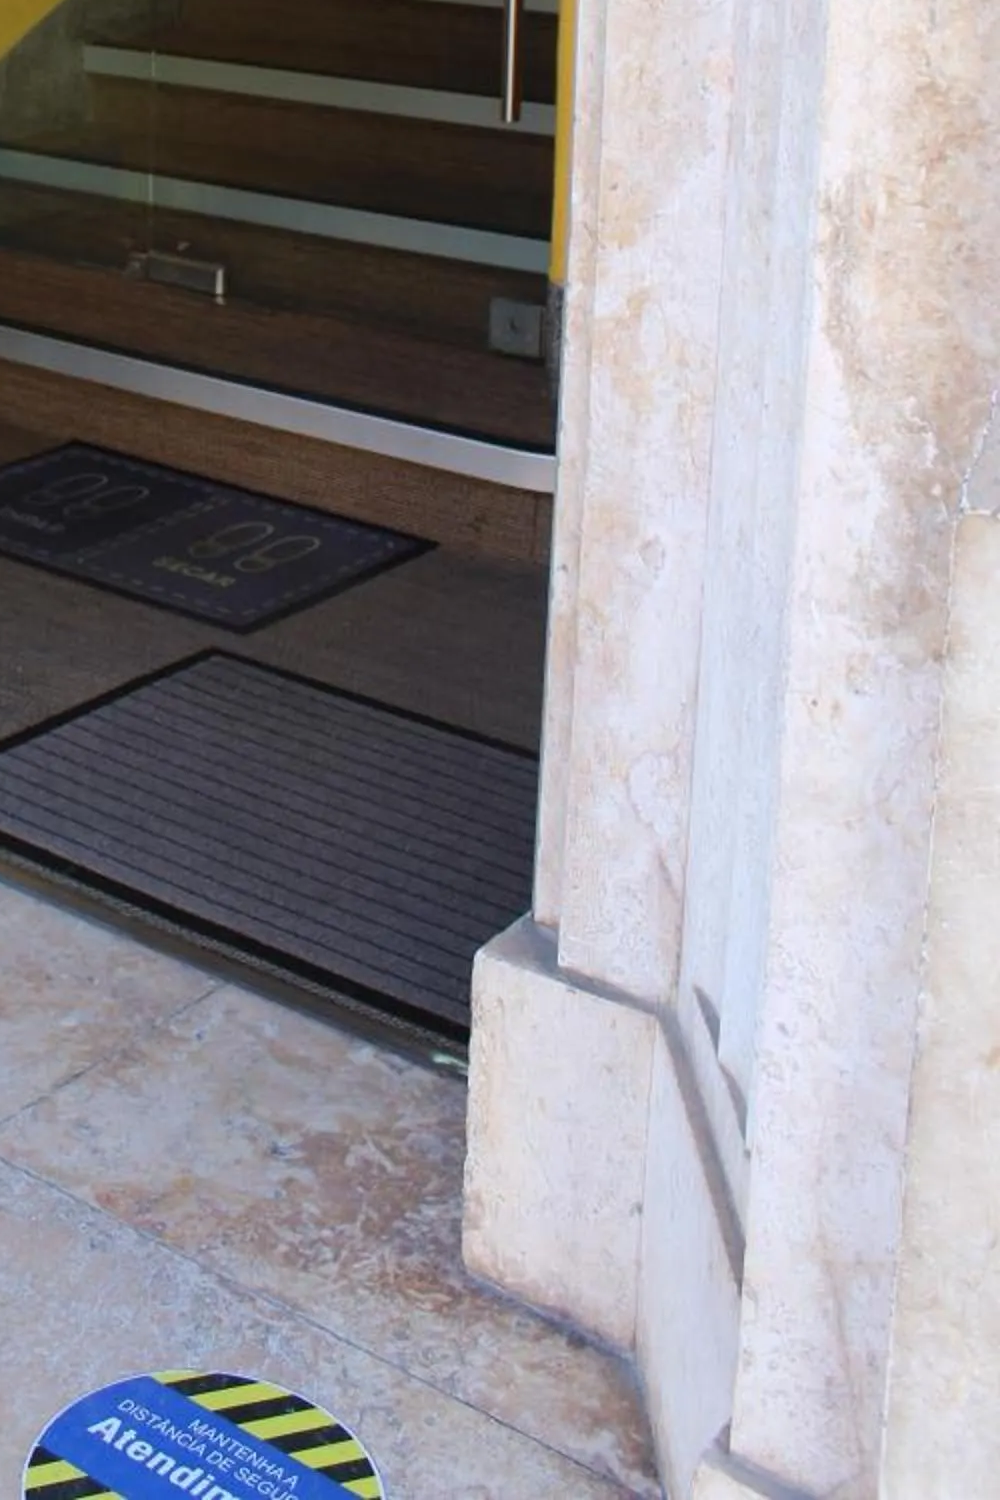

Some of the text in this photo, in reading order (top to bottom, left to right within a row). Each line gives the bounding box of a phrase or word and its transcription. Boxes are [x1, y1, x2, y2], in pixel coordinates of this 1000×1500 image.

[117, 1398, 207, 1457] DISTÂNCIA
[205, 1450, 236, 1473] DE
[187, 1419, 299, 1492] MANTENHA A
